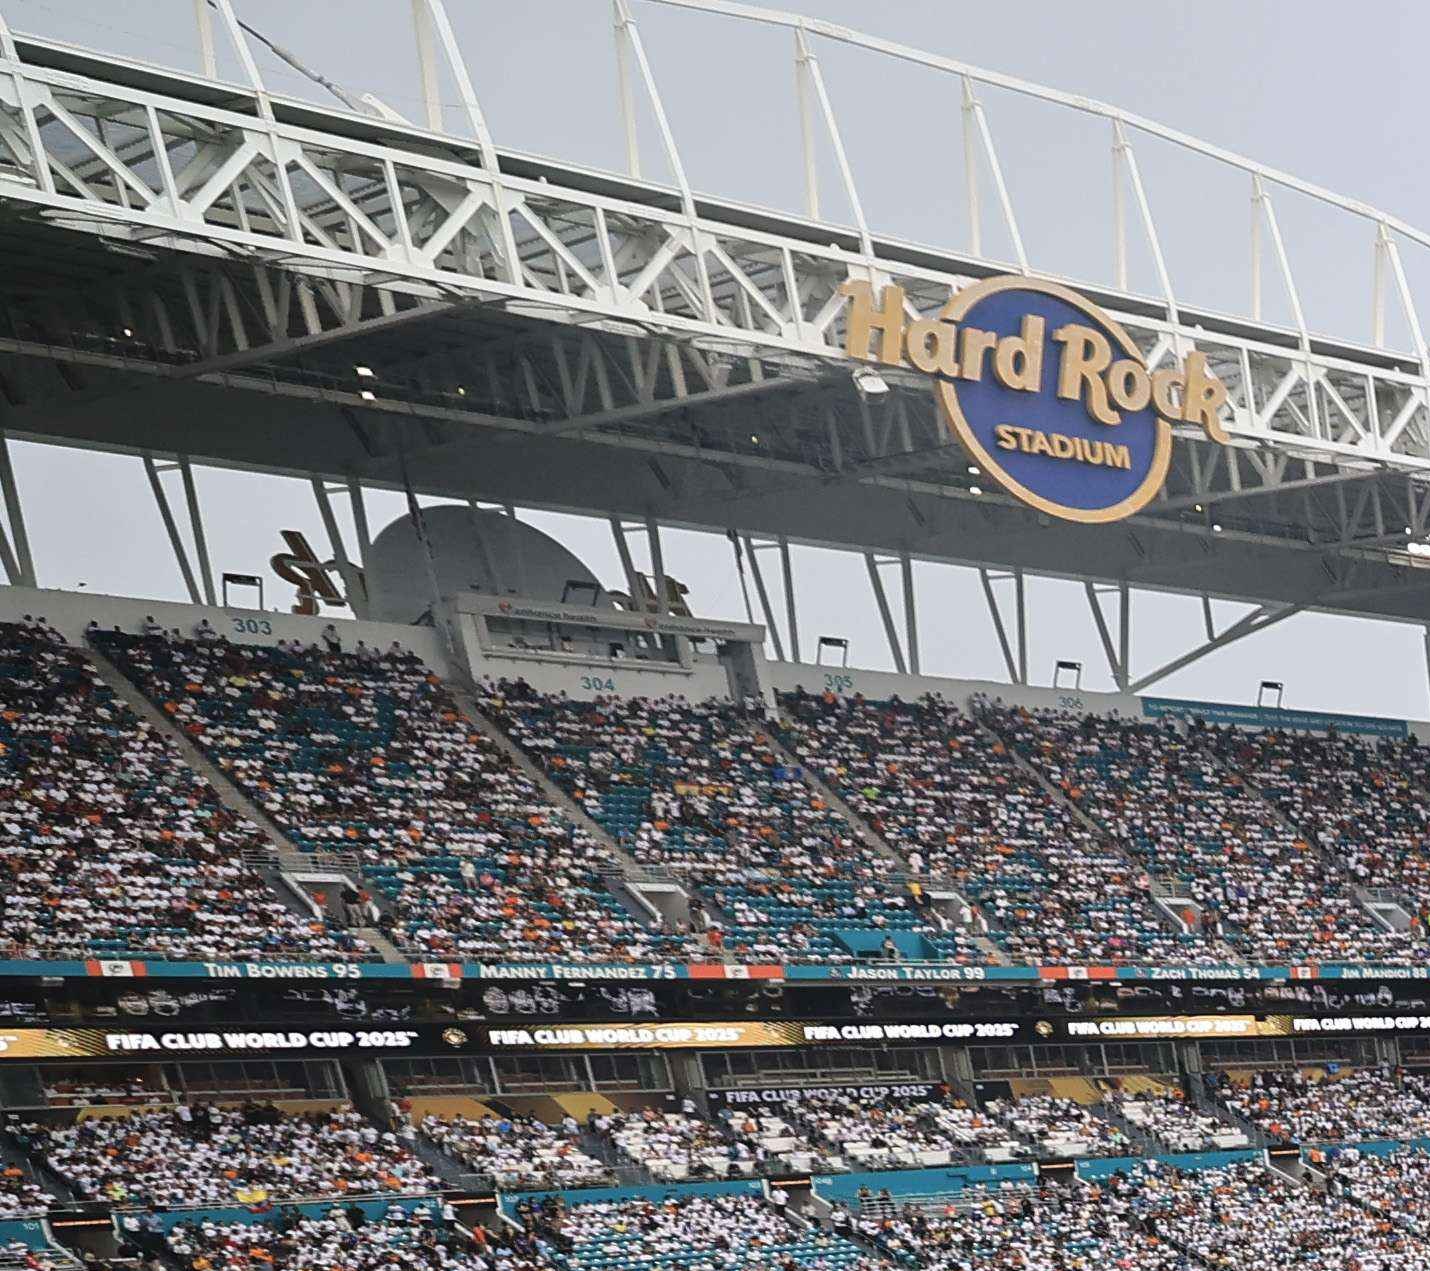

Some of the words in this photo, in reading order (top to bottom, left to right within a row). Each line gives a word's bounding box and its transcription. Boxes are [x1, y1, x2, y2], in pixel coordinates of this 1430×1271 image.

[839, 279, 1045, 392] Hard
[1053, 323, 1231, 446] Rock
[995, 424, 1132, 470] STADIUM
[233, 618, 272, 635] 303
[581, 676, 616, 692] 304
[204, 963, 242, 978] TIM
[247, 963, 329, 979] BOWENS
[332, 964, 361, 979] 95
[480, 965, 547, 979] MANNY
[553, 966, 648, 980] FERNANDEZ
[652, 966, 677, 980] 75
[847, 966, 899, 979] JASON
[902, 966, 959, 980] TAYLOR
[962, 967, 985, 980] 99
[1152, 968, 1185, 980] ZACH
[1188, 968, 1240, 980] THOMAS
[1242, 968, 1260, 980] 54
[1341, 967, 1359, 979] JIM
[803, 1026, 842, 1040] FIFA
[842, 1025, 884, 1039] CLUB
[883, 1024, 942, 1038] WORLD
[942, 1023, 975, 1037] CUP
[106, 1034, 160, 1050] FIFA
[161, 1033, 224, 1049] CLUB
[224, 1032, 307, 1048] WORLD
[308, 1031, 354, 1047] CUP
